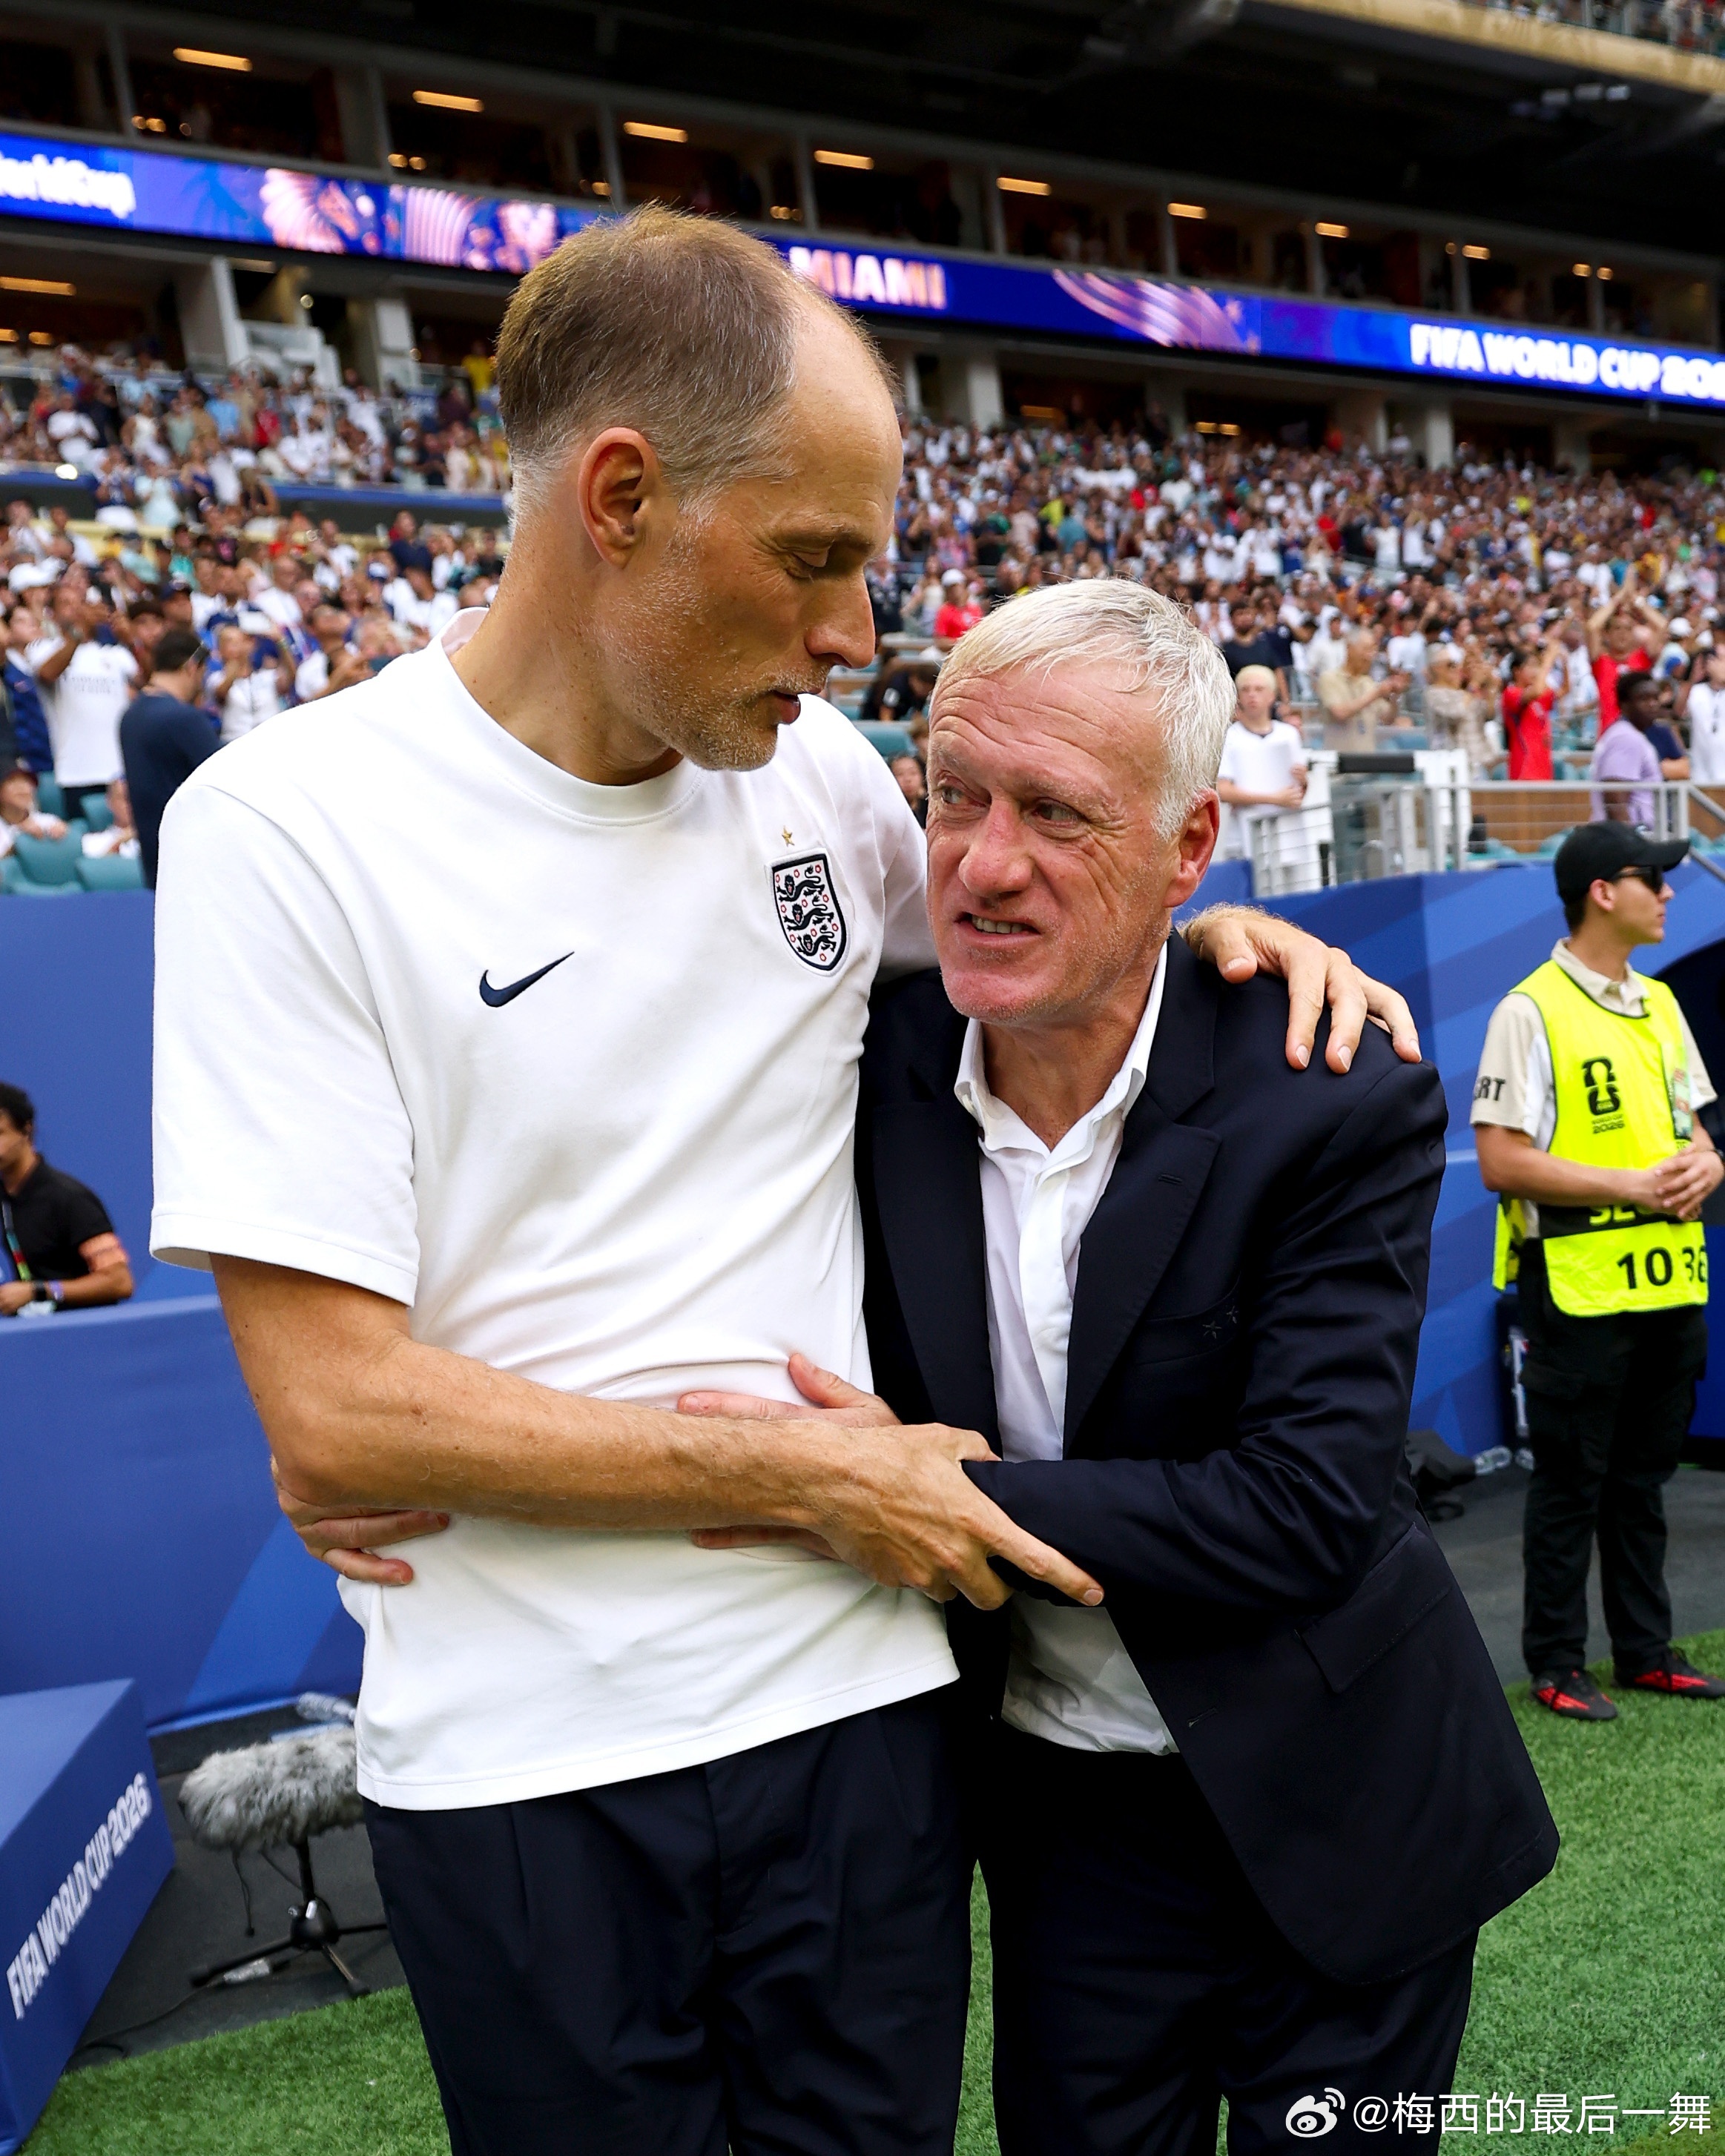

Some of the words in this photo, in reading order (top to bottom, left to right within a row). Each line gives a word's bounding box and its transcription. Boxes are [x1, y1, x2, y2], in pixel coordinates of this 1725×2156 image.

[789, 246, 946, 309] MIAMI
[1410, 323, 1483, 371] FIFA
[1483, 332, 1598, 385] WORLD
[1598, 346, 1660, 392] CUP
[1473, 1076, 1506, 1102] RT
[6, 1932, 49, 2020] FIFA
[37, 1859, 93, 1966] WORLD
[85, 1823, 113, 1891] CUP
[107, 1772, 151, 1857] 2026
